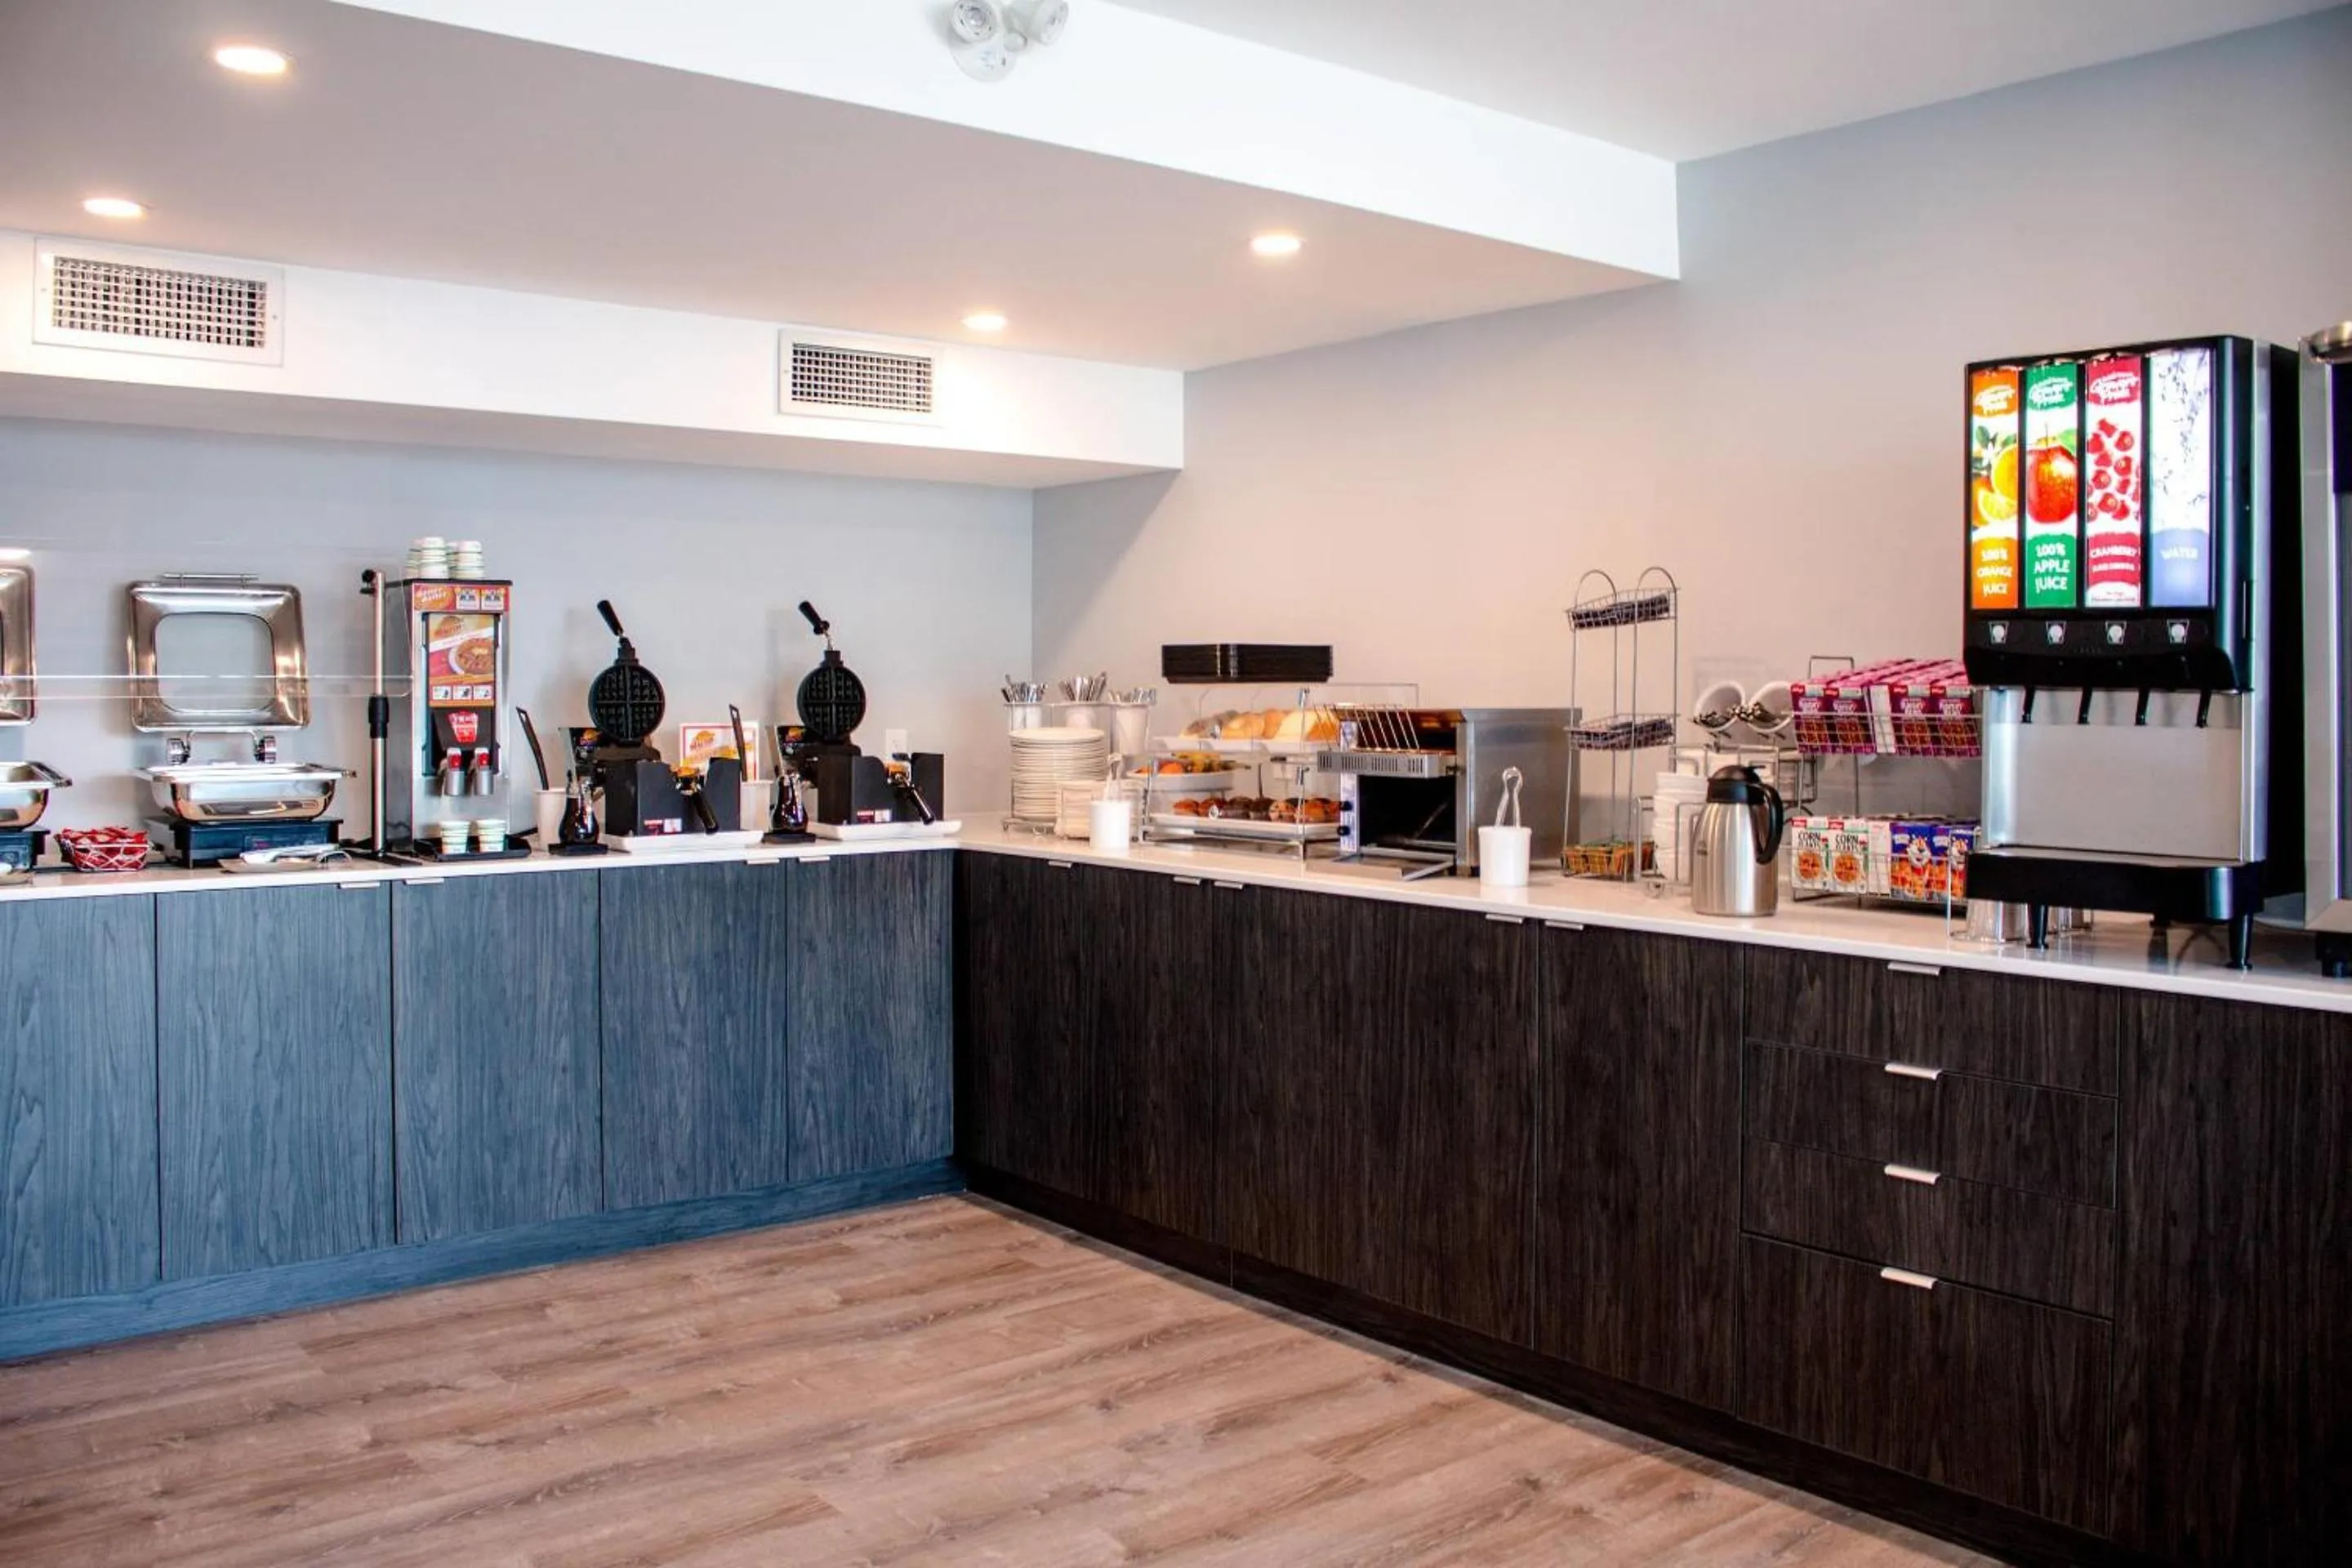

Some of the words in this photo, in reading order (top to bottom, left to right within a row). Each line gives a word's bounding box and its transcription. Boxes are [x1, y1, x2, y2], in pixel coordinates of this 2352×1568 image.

[2160, 546, 2198, 560] WATER
[2034, 559, 2070, 573] APPLE
[2035, 577, 2068, 594] JUICE
[1798, 831, 1820, 840] CORN
[1835, 835, 1859, 844] CORN
